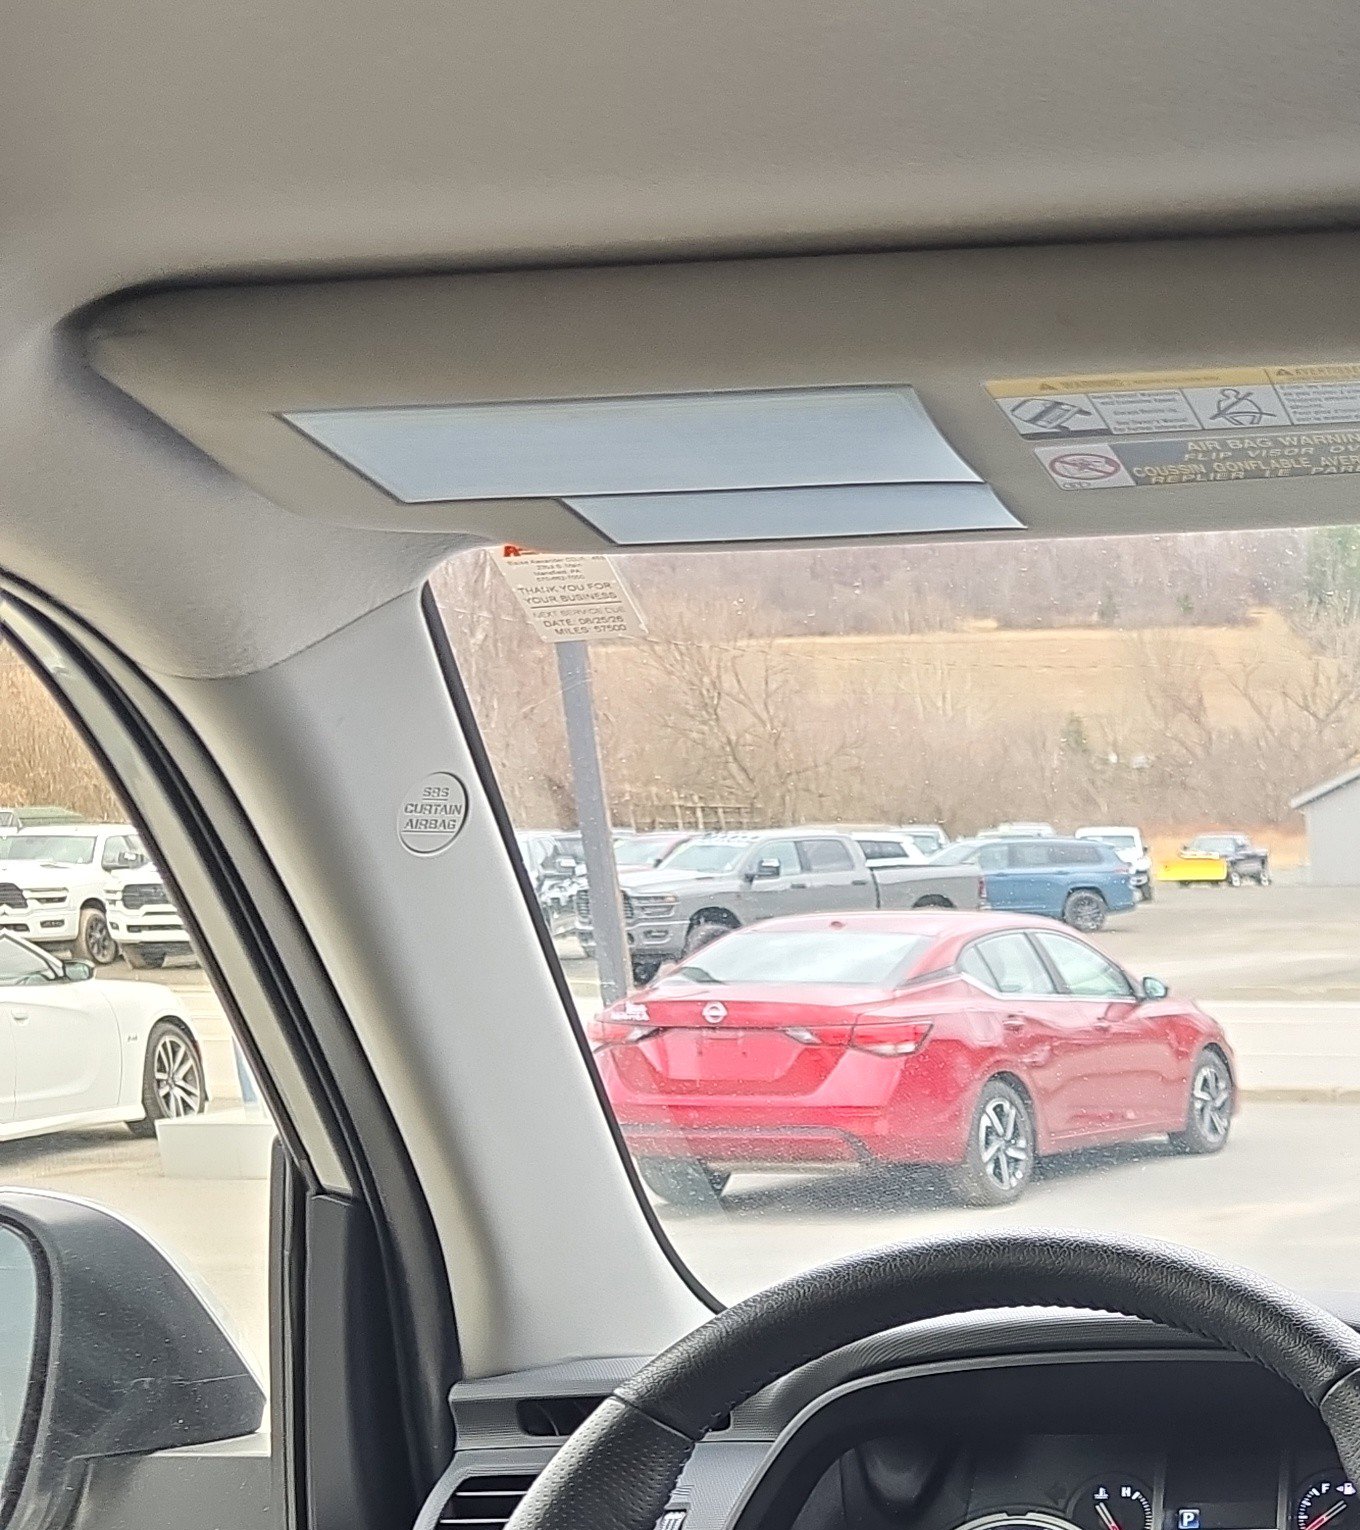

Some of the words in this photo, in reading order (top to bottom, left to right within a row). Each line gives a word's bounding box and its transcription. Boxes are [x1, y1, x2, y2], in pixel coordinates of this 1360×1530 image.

[1187, 441, 1222, 451] AIR
[1226, 437, 1271, 449] BAG
[1183, 452, 1233, 462] FLIP
[1247, 447, 1314, 458] VISOR
[1132, 463, 1207, 477] COUSSIN
[1212, 456, 1312, 473] GONFLABLE
[1151, 471, 1246, 485] REPLIER
[518, 586, 558, 595] THANK
[561, 584, 584, 592] YOU
[587, 582, 612, 590] FOR
[524, 596, 557, 604] YOUR
[559, 592, 618, 603] BUSINESS
[423, 787, 449, 797] SRS
[404, 803, 463, 815] CURTAIN
[404, 818, 456, 830] AIRBAG
[1121, 1486, 1131, 1497] H
[1321, 1483, 1330, 1493] F
[1183, 1514, 1195, 1526] P
